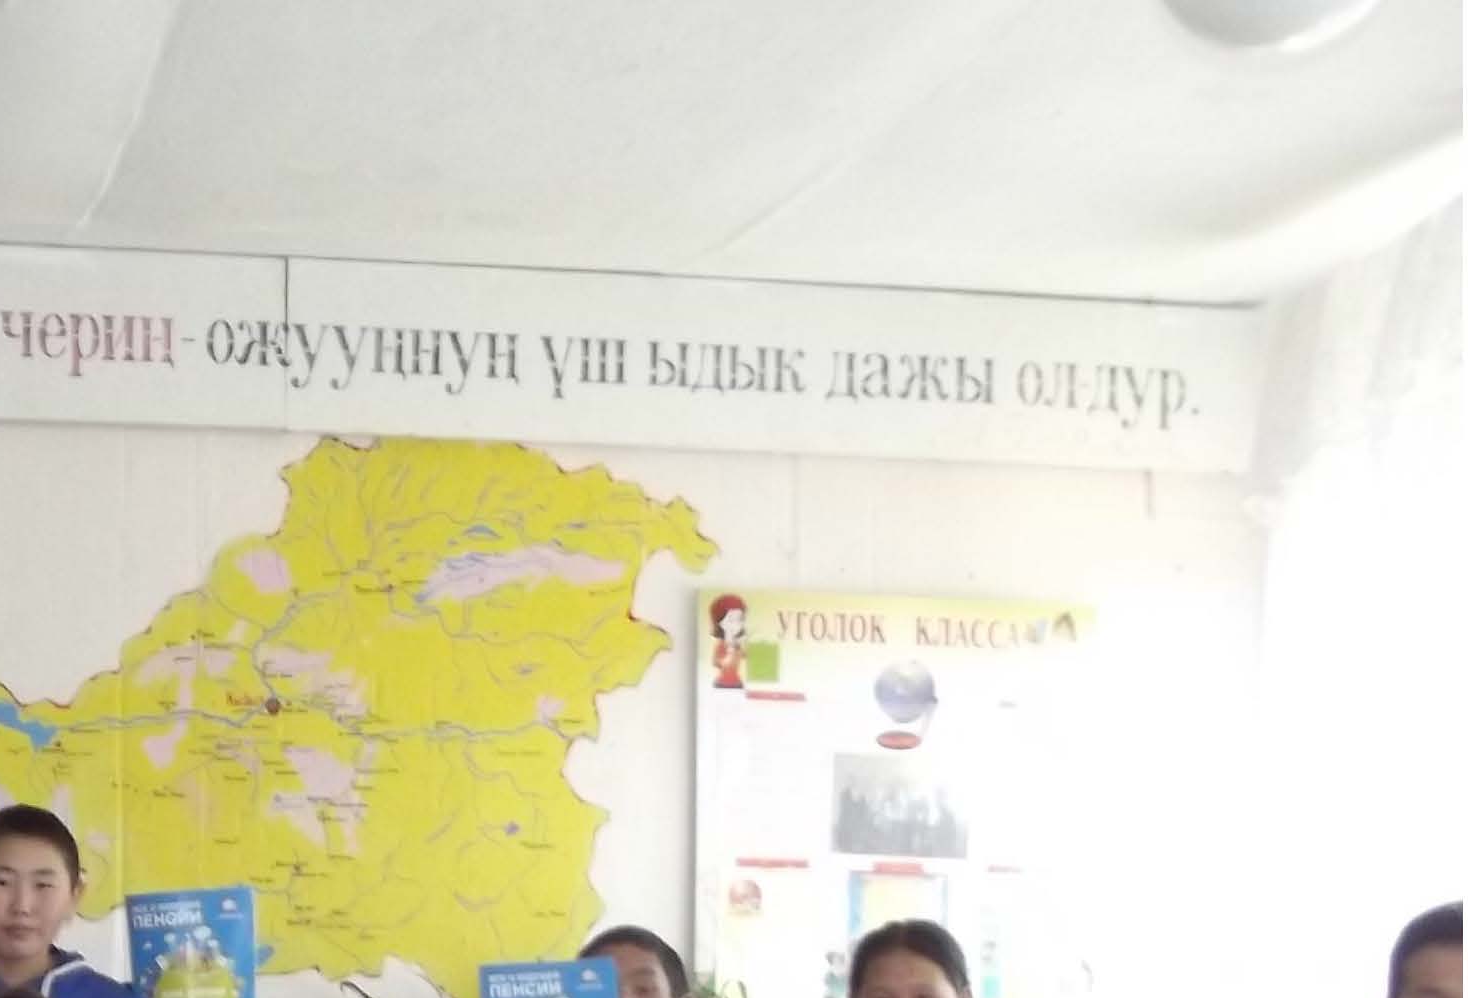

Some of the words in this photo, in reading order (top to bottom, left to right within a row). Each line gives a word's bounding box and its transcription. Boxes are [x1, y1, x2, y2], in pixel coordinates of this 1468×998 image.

[647, 340, 806, 396] ыдык
[824, 348, 995, 406] дажы
[776, 611, 886, 645] УГОЛОК
[915, 616, 1022, 648] КЛАССА
